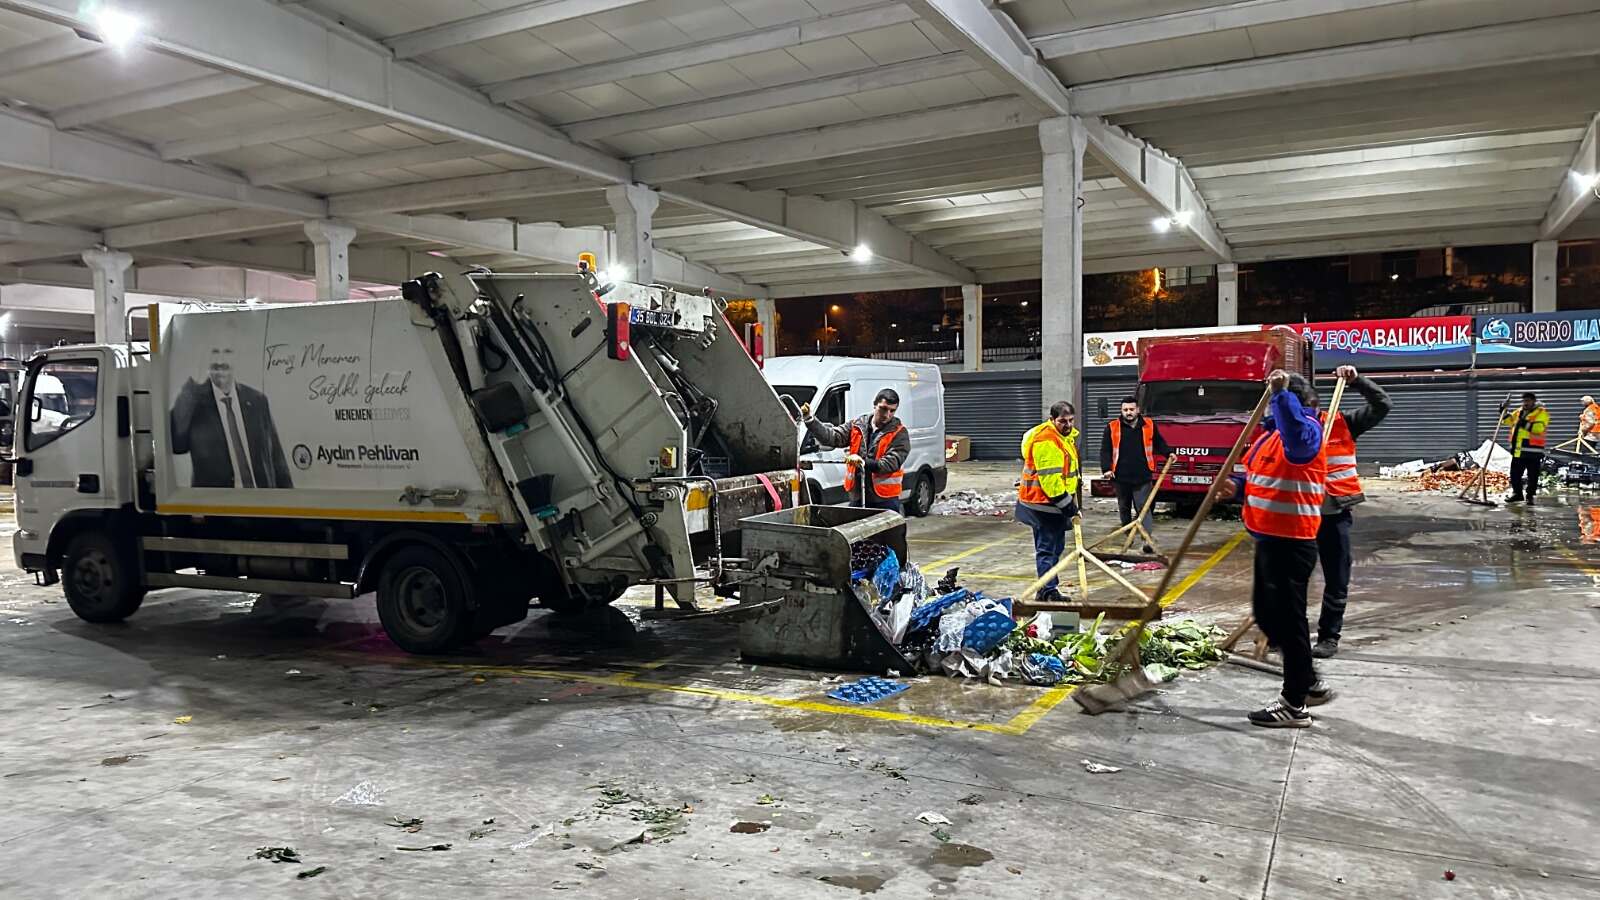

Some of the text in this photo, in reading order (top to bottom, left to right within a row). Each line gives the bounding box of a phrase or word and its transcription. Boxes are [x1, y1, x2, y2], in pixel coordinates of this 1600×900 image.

[636, 310, 645, 323] 35
[1326, 329, 1373, 353] FOÇA
[1375, 325, 1470, 350] BALIKÇILIK
[1515, 318, 1600, 343] BORDO MA
[301, 343, 360, 367] Menemen
[1113, 341, 1137, 356] TA
[364, 370, 411, 404] gelecek
[317, 445, 419, 464] Aydın Pehlivan
[1176, 447, 1209, 456] ISUZU
